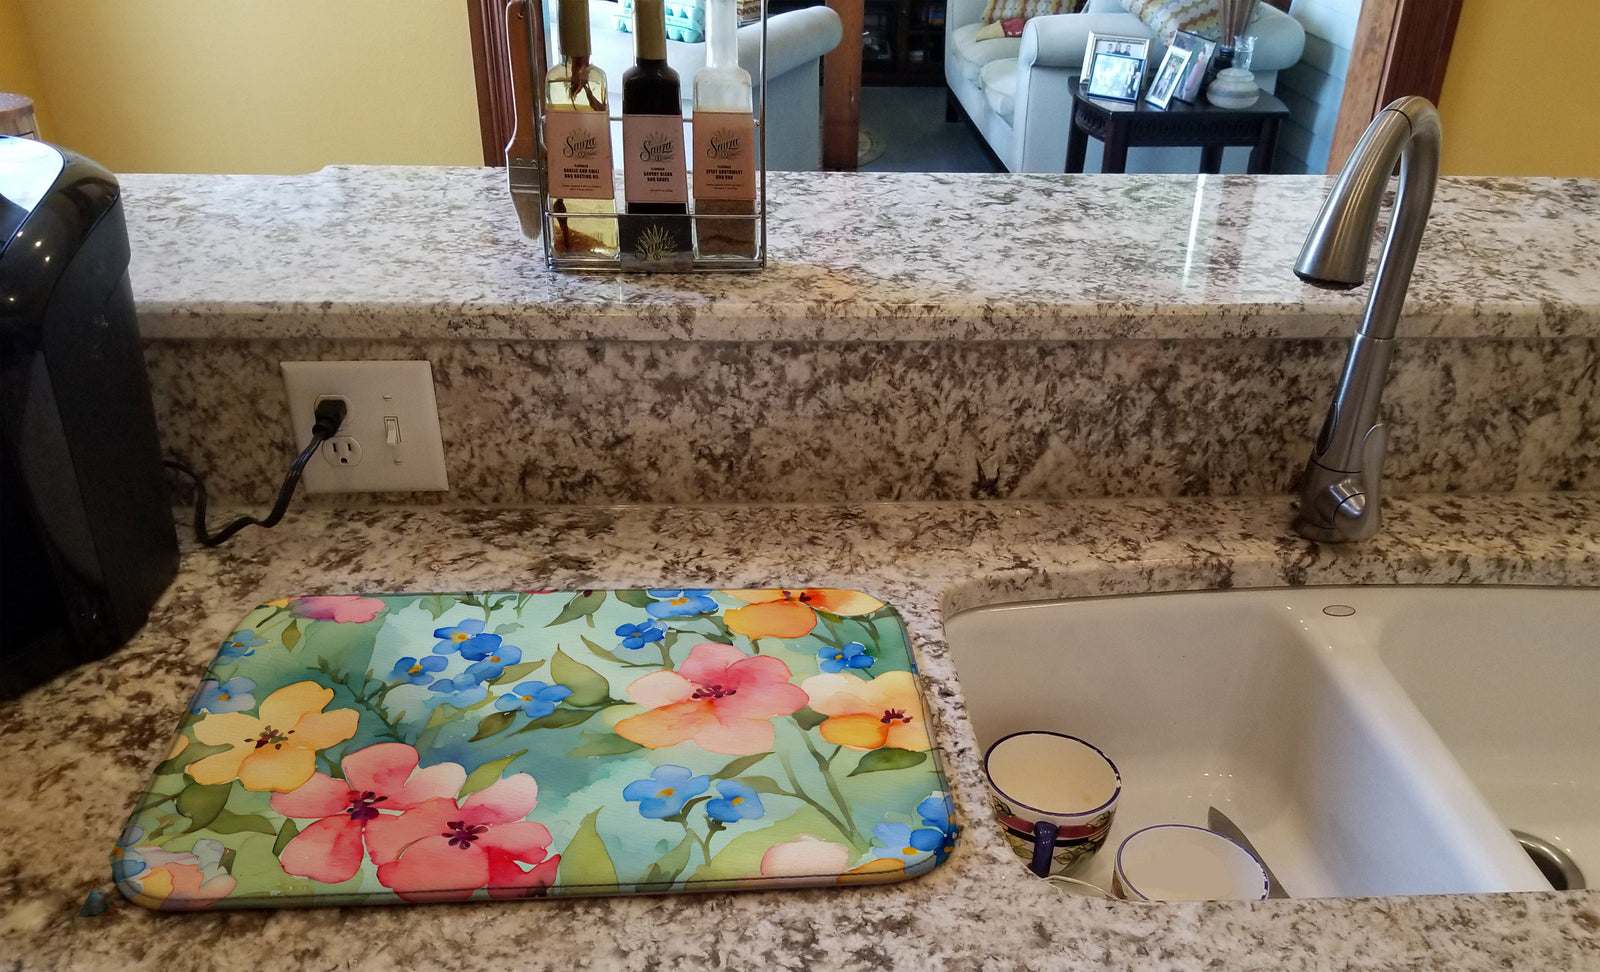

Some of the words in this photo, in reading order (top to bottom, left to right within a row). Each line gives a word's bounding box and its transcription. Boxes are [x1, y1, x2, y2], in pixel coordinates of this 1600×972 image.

[562, 136, 598, 158] Sauza
[640, 140, 674, 162] Sauza
[706, 136, 741, 159] Sauza
